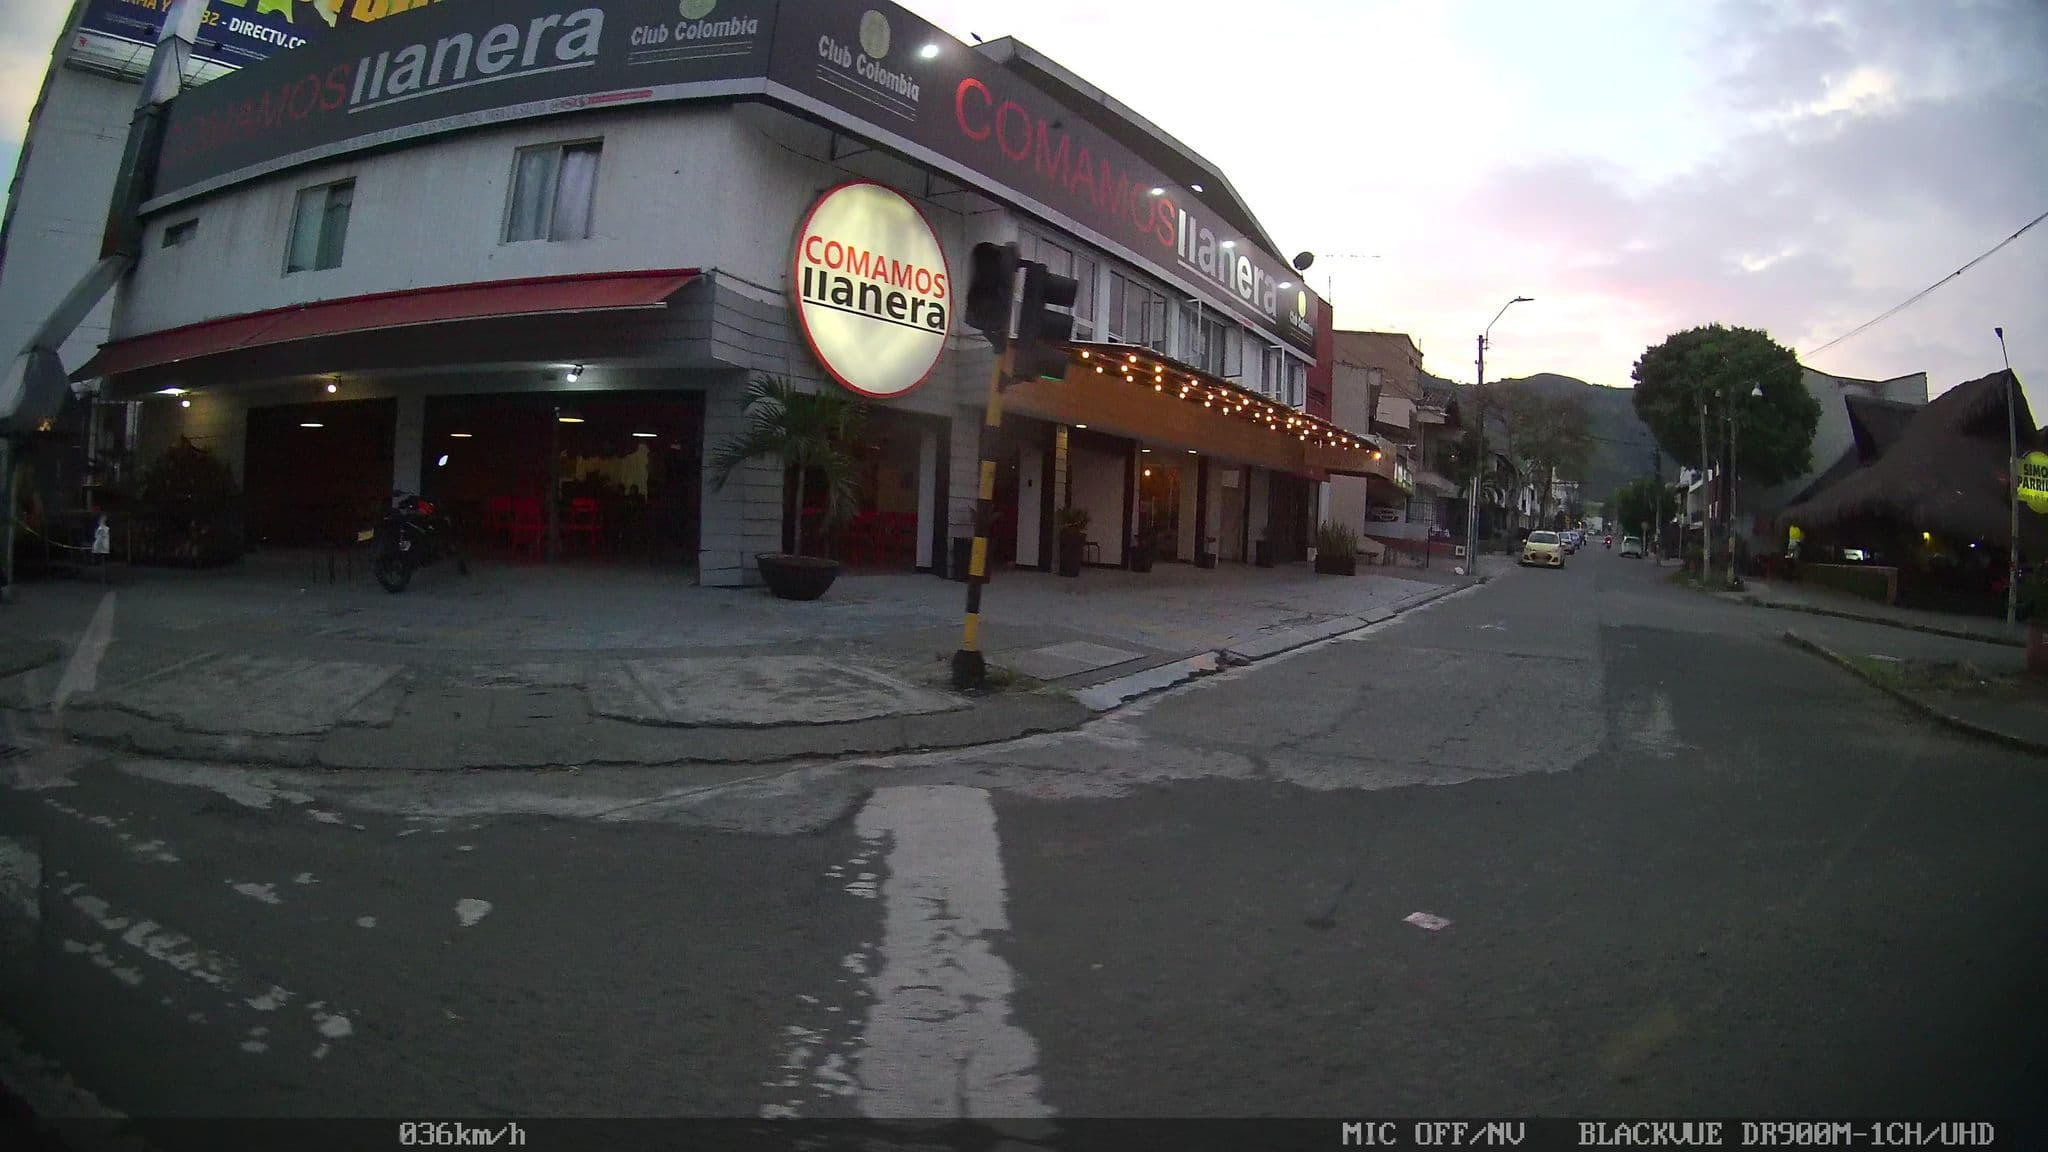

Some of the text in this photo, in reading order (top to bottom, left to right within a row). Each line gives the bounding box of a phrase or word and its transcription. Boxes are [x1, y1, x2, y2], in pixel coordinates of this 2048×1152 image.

[349, 8, 605, 104] llanera
[630, 16, 758, 46] Club Colombia
[818, 35, 920, 102] Club Colombia
[955, 77, 1278, 317] COMAMOS llanera
[803, 235, 946, 330] COMAMOS llanera
